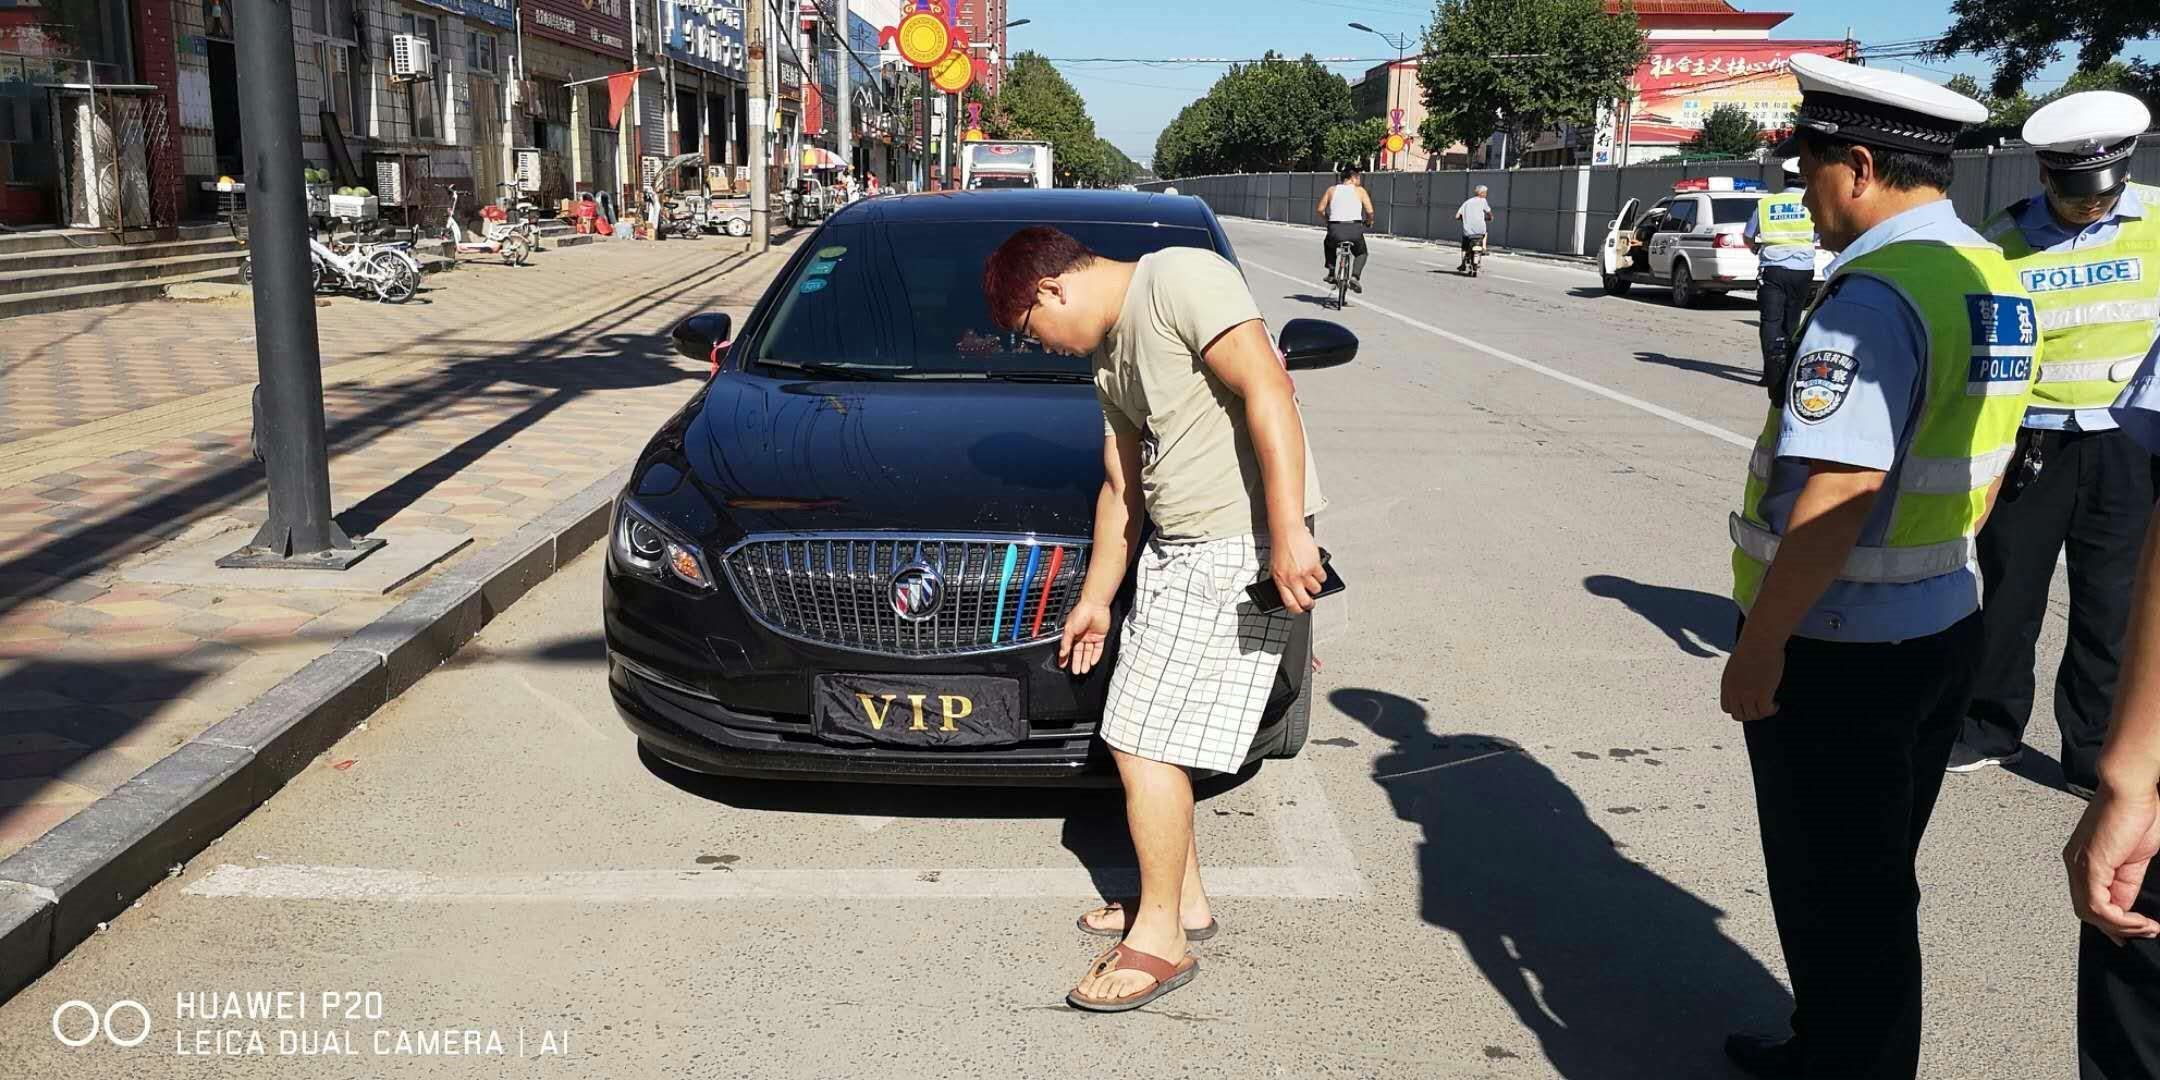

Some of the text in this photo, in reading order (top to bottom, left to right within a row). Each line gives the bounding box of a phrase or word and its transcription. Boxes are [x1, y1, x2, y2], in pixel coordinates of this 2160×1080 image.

[2032, 262, 2131, 289] POLICE
[1979, 299, 2033, 344] 警察
[855, 693, 973, 731] VIP
